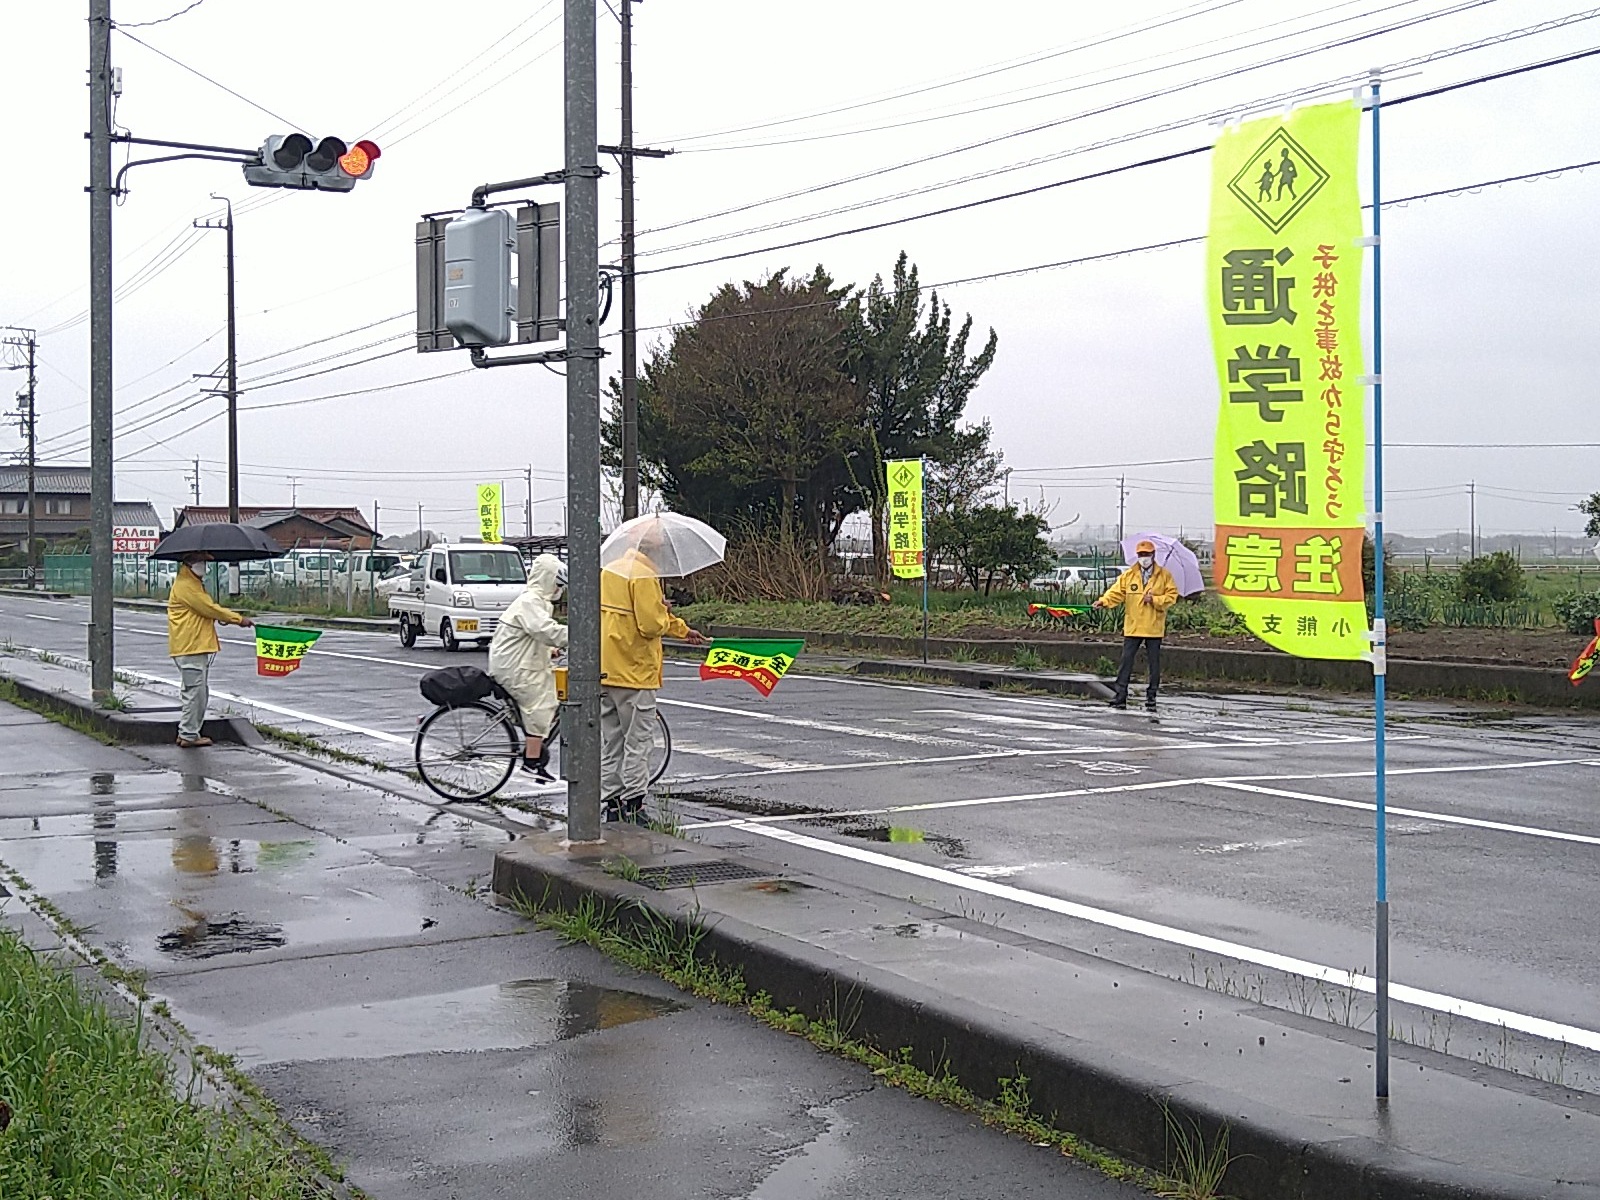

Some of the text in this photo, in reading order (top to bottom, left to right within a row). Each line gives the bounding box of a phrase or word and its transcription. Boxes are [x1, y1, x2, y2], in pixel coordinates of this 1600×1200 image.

[261, 641, 310, 658] 交通安全
[712, 650, 787, 676] 交通安全
